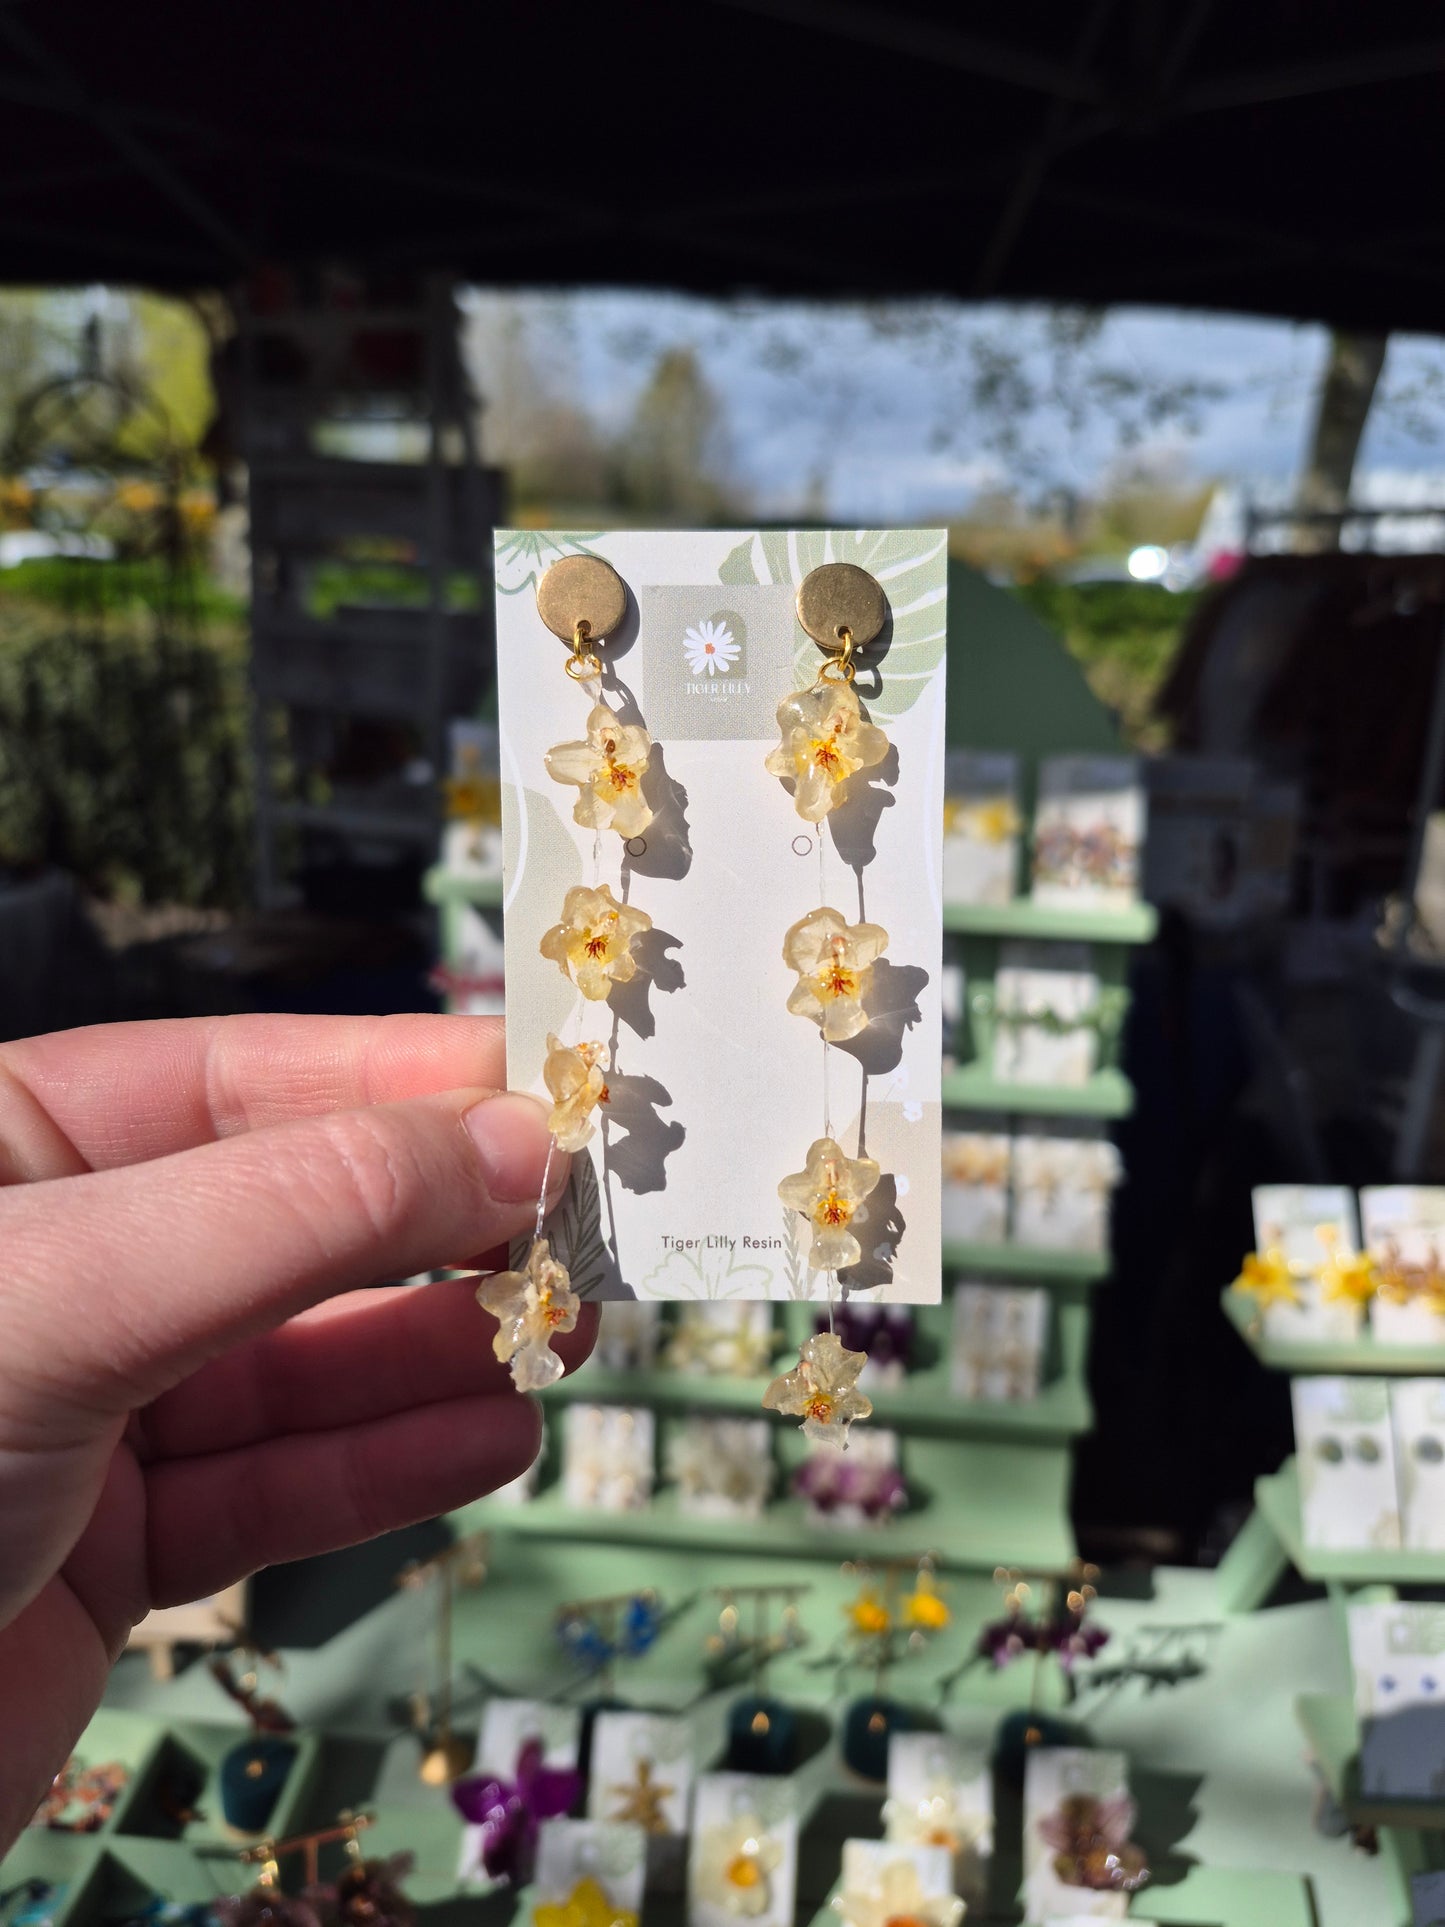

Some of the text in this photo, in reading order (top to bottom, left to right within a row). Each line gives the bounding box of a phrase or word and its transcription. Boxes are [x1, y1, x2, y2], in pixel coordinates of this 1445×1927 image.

[661, 1235, 782, 1252] Tiger Lilly Resin
